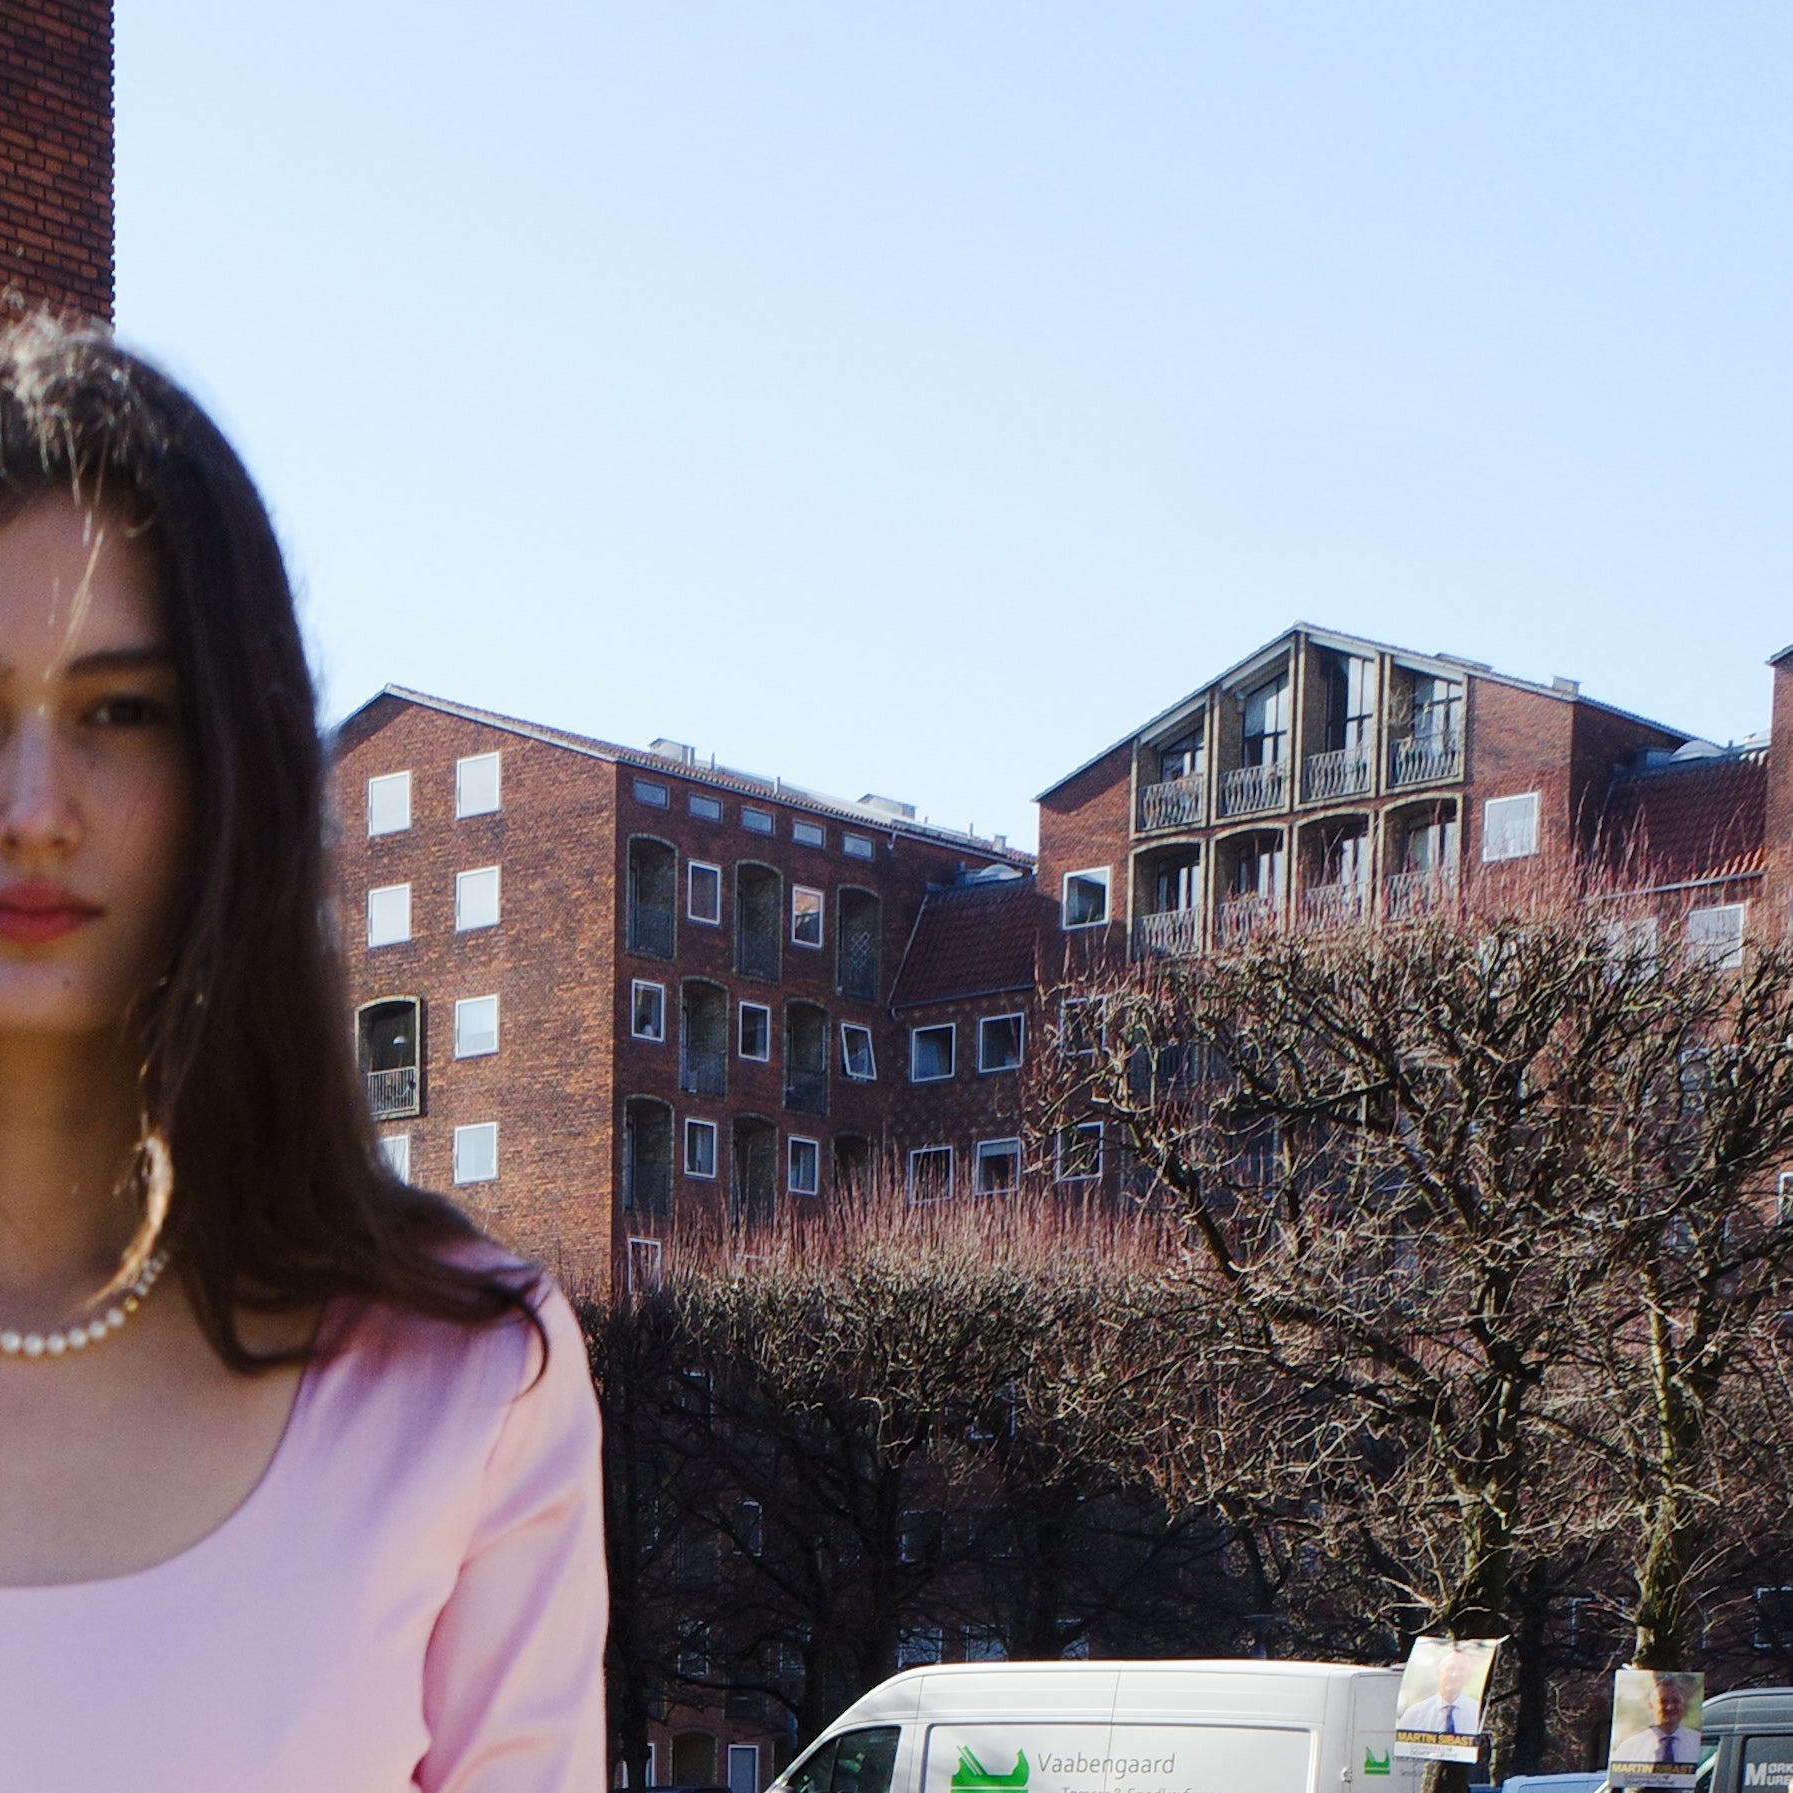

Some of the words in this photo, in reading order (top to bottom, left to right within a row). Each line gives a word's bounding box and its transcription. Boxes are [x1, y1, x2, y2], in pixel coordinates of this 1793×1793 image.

[1397, 1731, 1437, 1743] MARTIN
[1038, 1752, 1175, 1780] Vaabengaard
[1611, 1763, 1655, 1774] MARTIN
